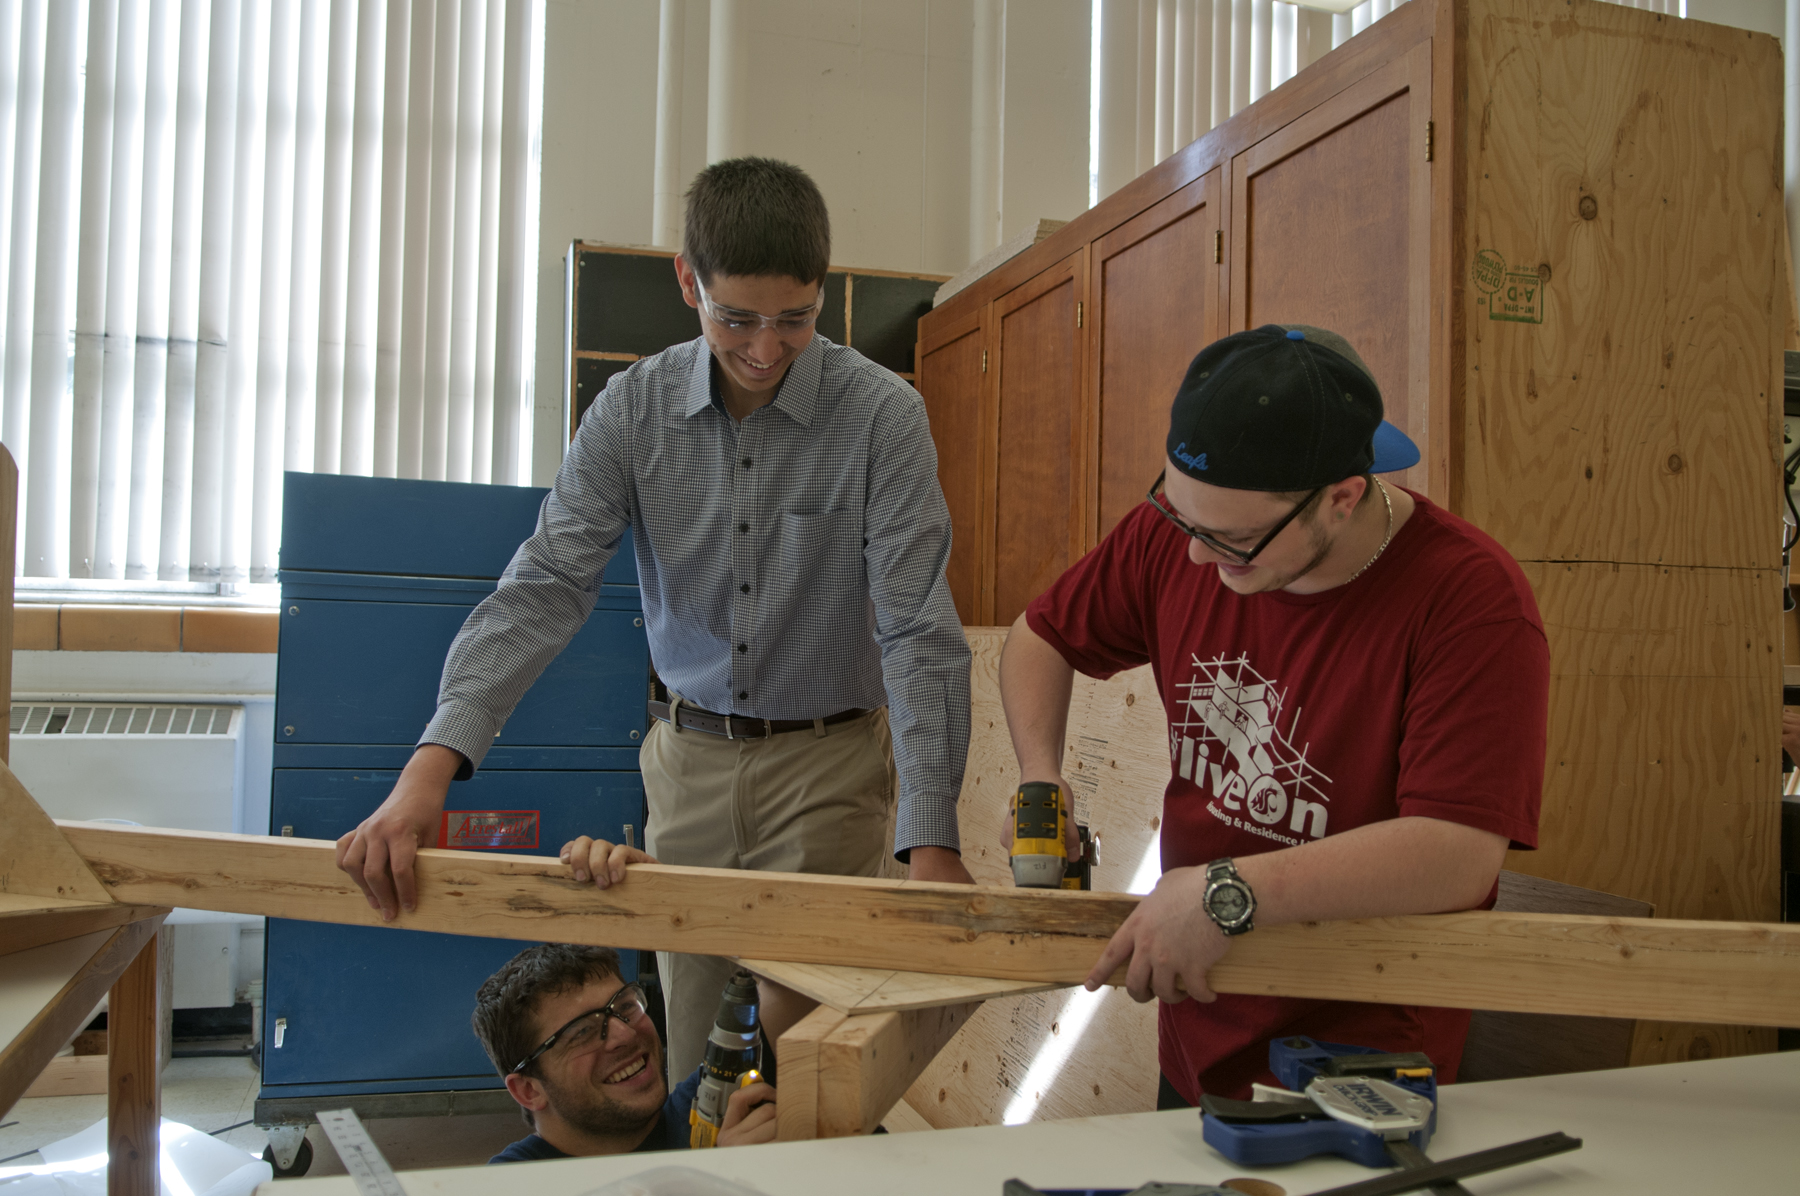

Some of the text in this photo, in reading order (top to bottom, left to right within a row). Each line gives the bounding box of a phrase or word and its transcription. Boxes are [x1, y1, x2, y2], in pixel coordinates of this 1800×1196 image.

[1475, 269, 1501, 289] DFPA
[452, 816, 525, 839] Arrestall
[1233, 816, 1243, 830] &
[1243, 821, 1298, 846] Residence
[711, 1066, 718, 1074] 19
[723, 1070, 732, 1078] 21
[1346, 1083, 1403, 1117] IRWIN
